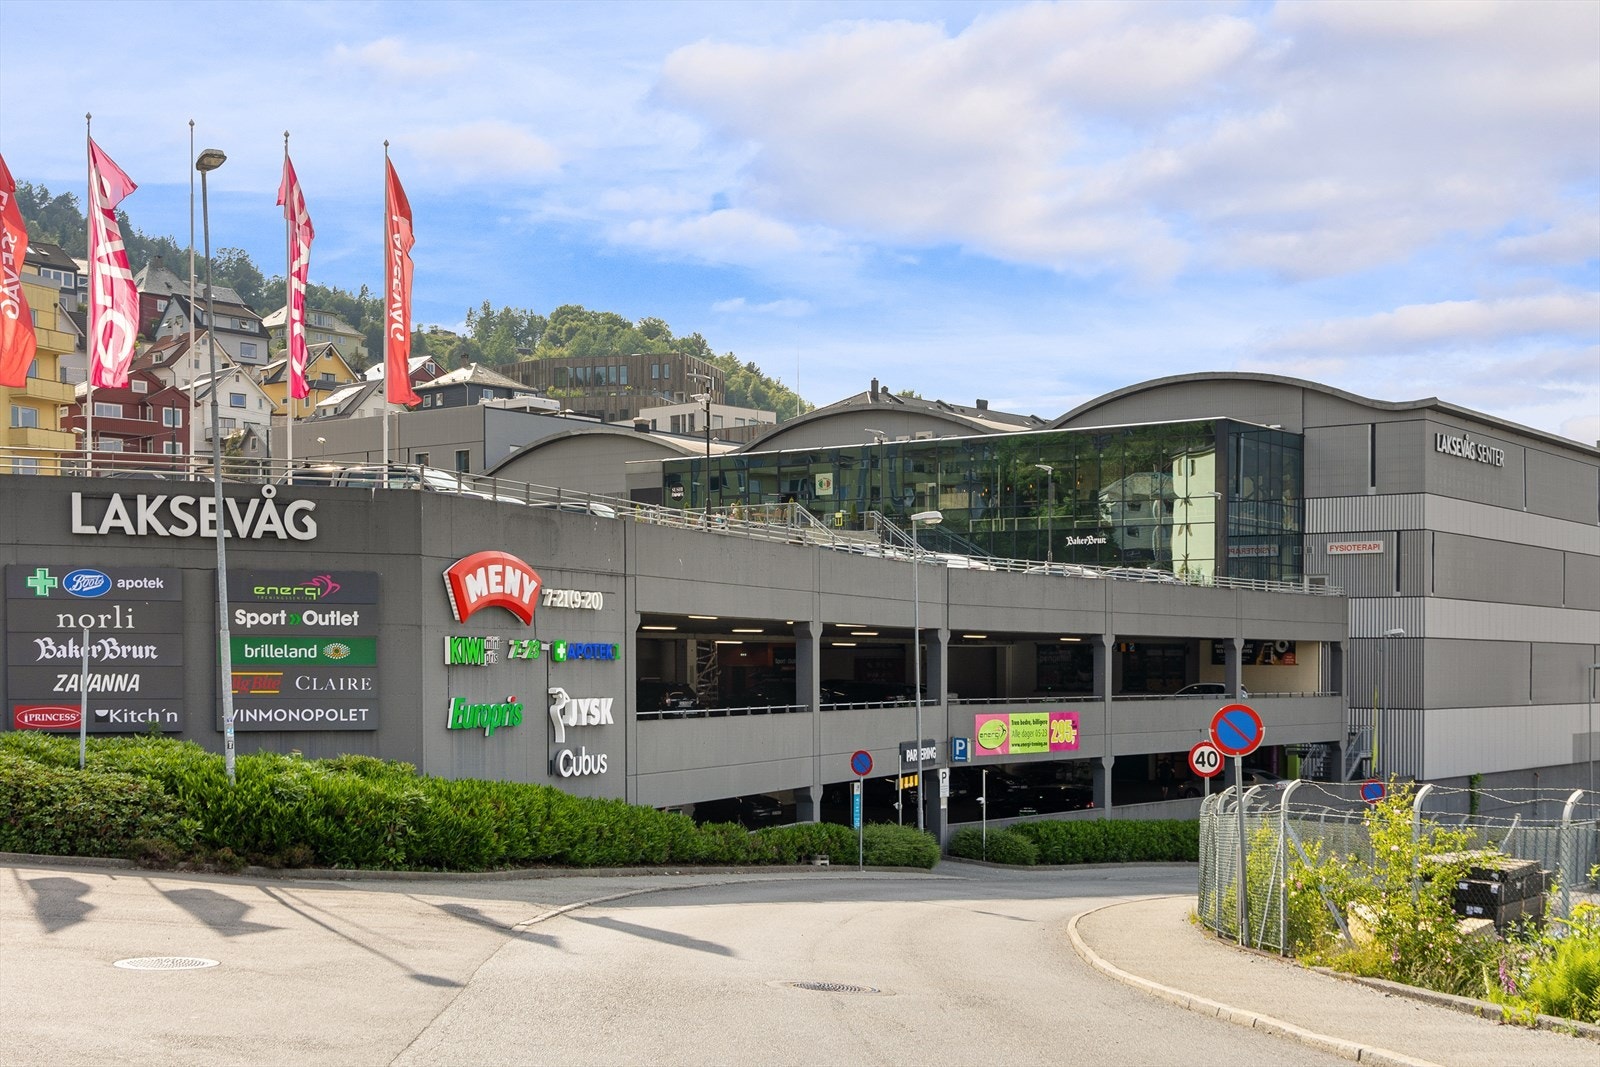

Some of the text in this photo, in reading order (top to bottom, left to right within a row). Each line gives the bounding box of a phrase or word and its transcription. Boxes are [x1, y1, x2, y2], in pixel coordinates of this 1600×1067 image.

[1436, 432, 1505, 467] LAKSEVÅG SENTER
[71, 484, 318, 541] LAKSEVÅG
[1329, 542, 1381, 553] FYSIOTERAPI
[69, 574, 104, 592] Boots
[116, 577, 164, 591] apotek
[465, 564, 538, 604] MENY
[253, 585, 322, 601] energi
[56, 605, 135, 629] norli
[234, 608, 360, 628] Sport Outlet
[244, 643, 318, 659] brilleland
[446, 635, 486, 666] KIWI
[485, 636, 501, 650] mini
[485, 651, 499, 666] pris
[295, 675, 373, 691] CLAIRE
[28, 713, 78, 722] PRINCESS
[448, 695, 524, 737] Europris
[563, 697, 614, 726] JYSK
[906, 746, 937, 763] PARERING
[956, 739, 966, 756] P
[556, 746, 608, 778] Cubus
[1195, 750, 1219, 768] 40
[941, 771, 948, 785] P
